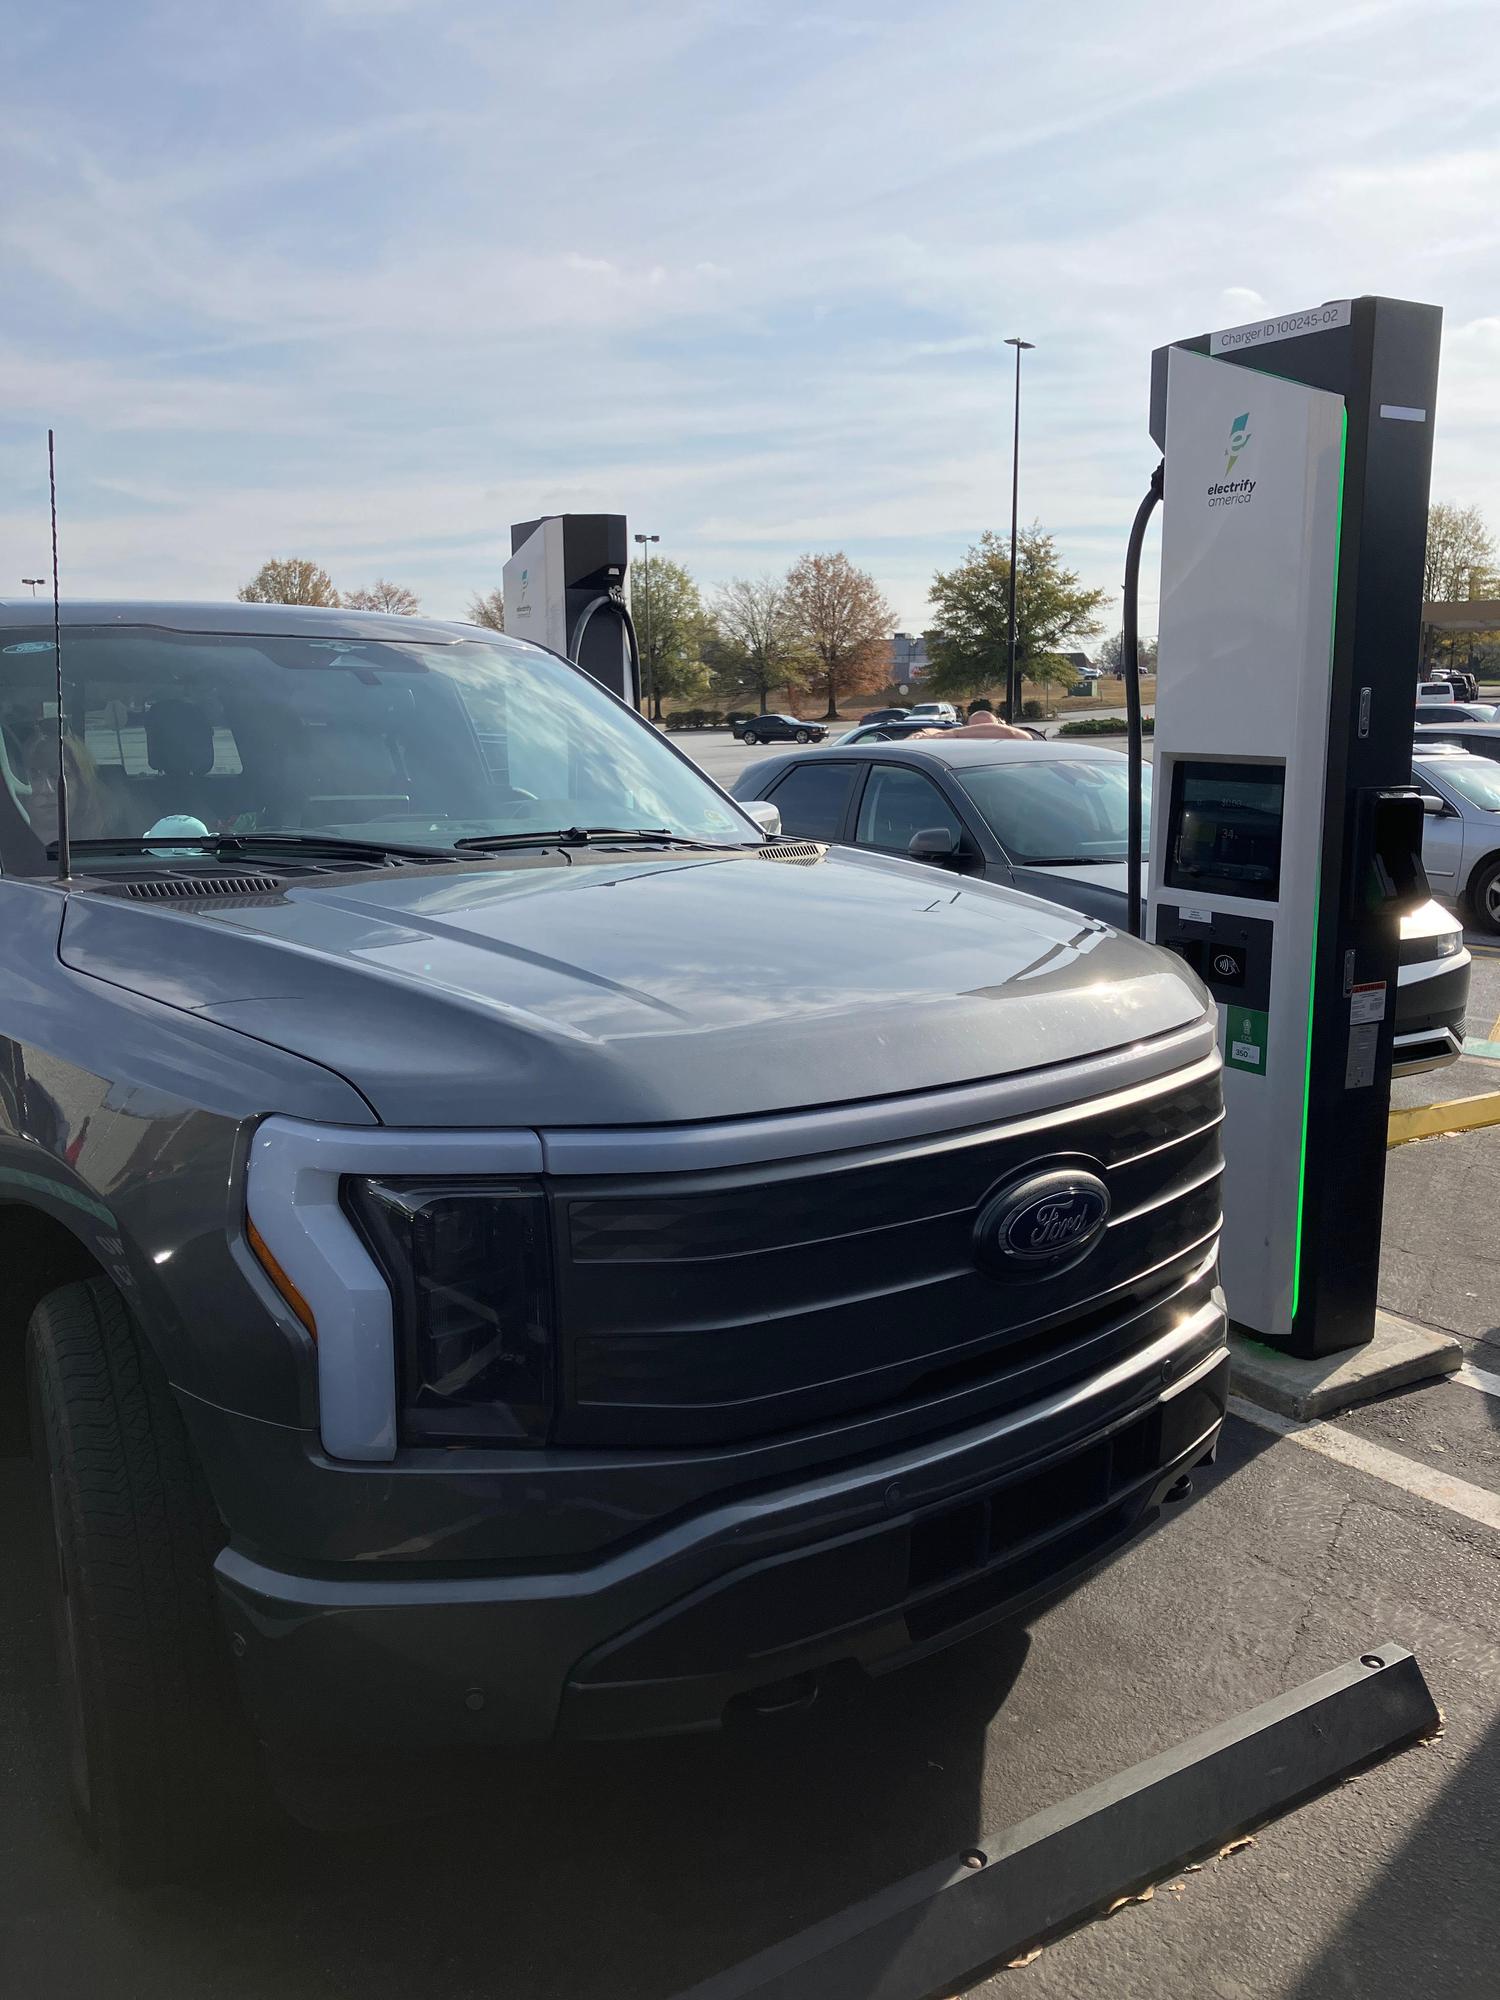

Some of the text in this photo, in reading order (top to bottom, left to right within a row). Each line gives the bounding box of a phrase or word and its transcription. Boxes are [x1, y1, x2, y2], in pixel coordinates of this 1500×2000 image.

[1221, 309, 1338, 346] Charger ID 100245-02
[1207, 479, 1256, 495] electrify
[1208, 493, 1252, 507] america
[1235, 1048, 1249, 1058] 350
[1030, 1199, 1092, 1247] Ford
